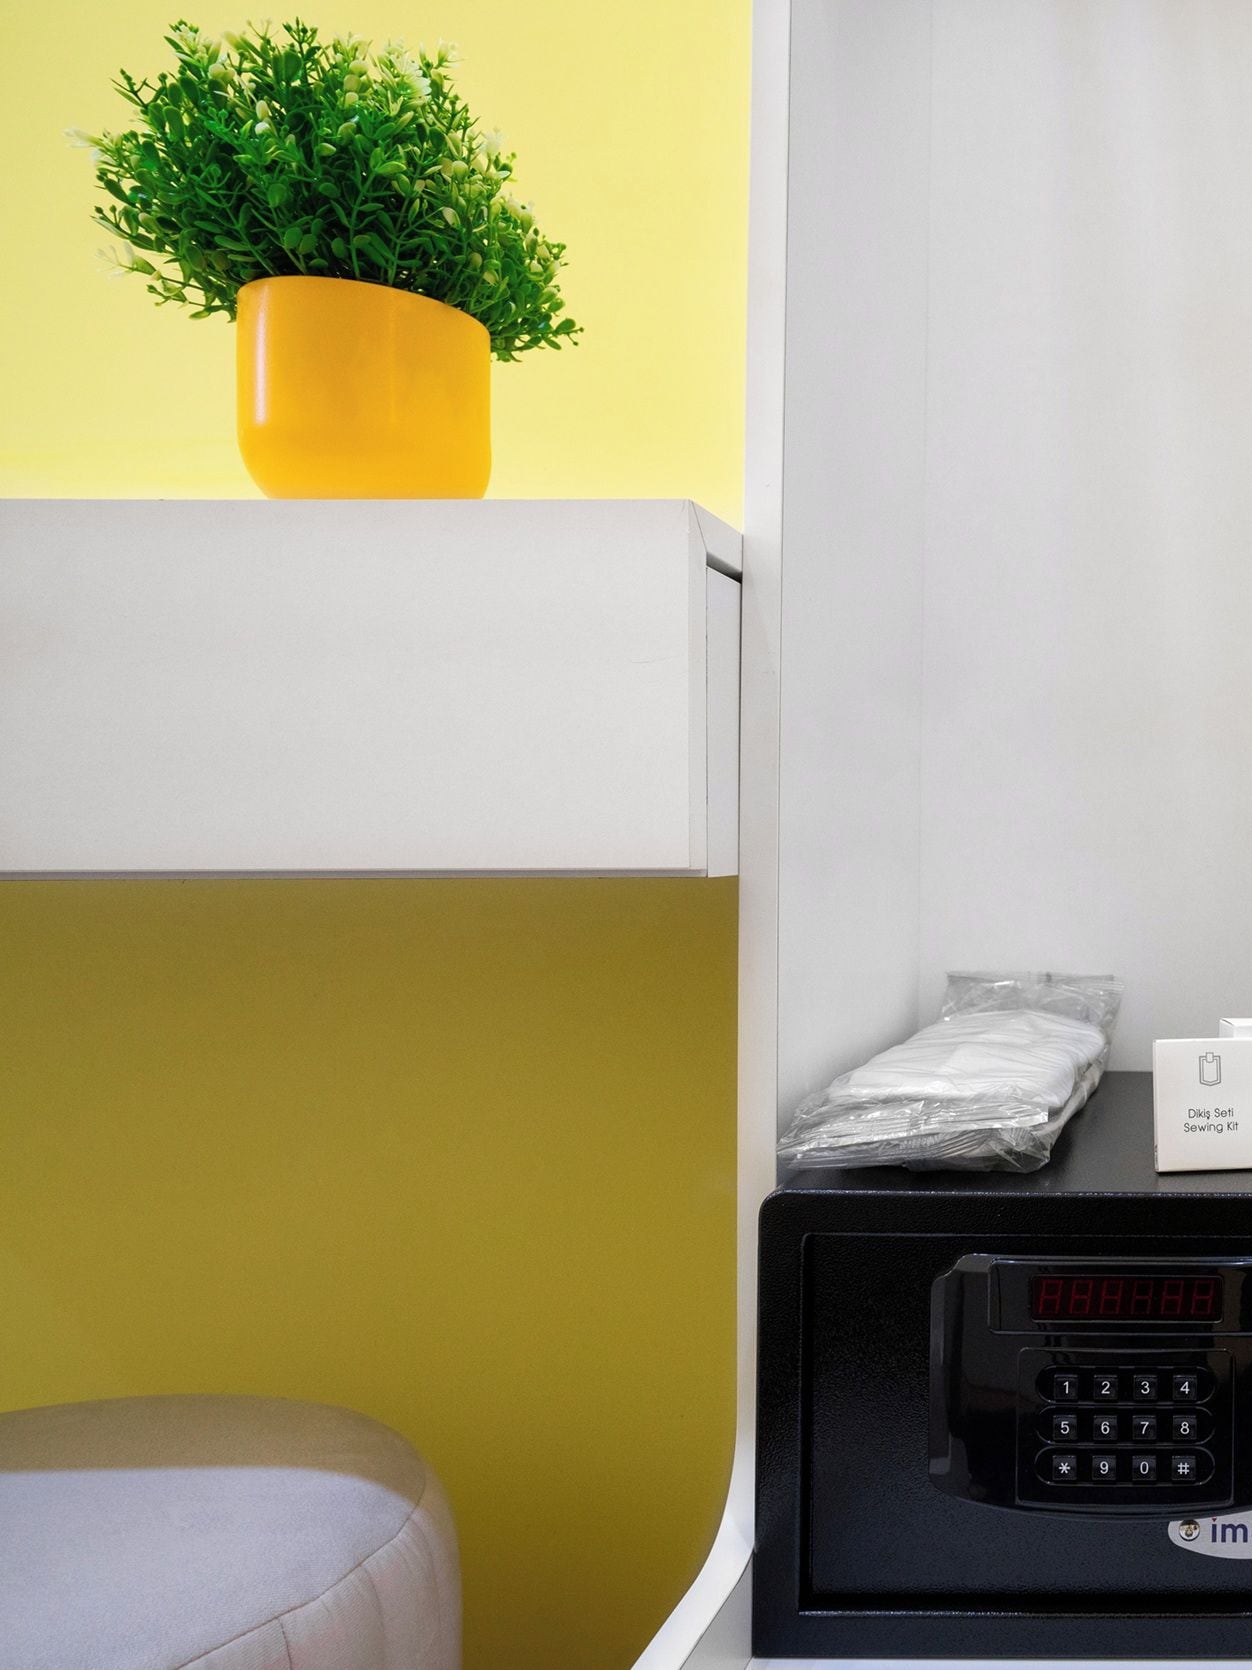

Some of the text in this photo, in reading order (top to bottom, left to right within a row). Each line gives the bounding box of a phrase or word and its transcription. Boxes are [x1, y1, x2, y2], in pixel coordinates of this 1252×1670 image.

[1188, 1108, 1234, 1119] Dikiş Seti
[1184, 1122, 1238, 1133] Sewing Kit
[1062, 1381, 1190, 1394] 1 2 3 4
[1060, 1421, 1190, 1434] 5 6 7 8
[1099, 1462, 1190, 1475] 9 0 #
